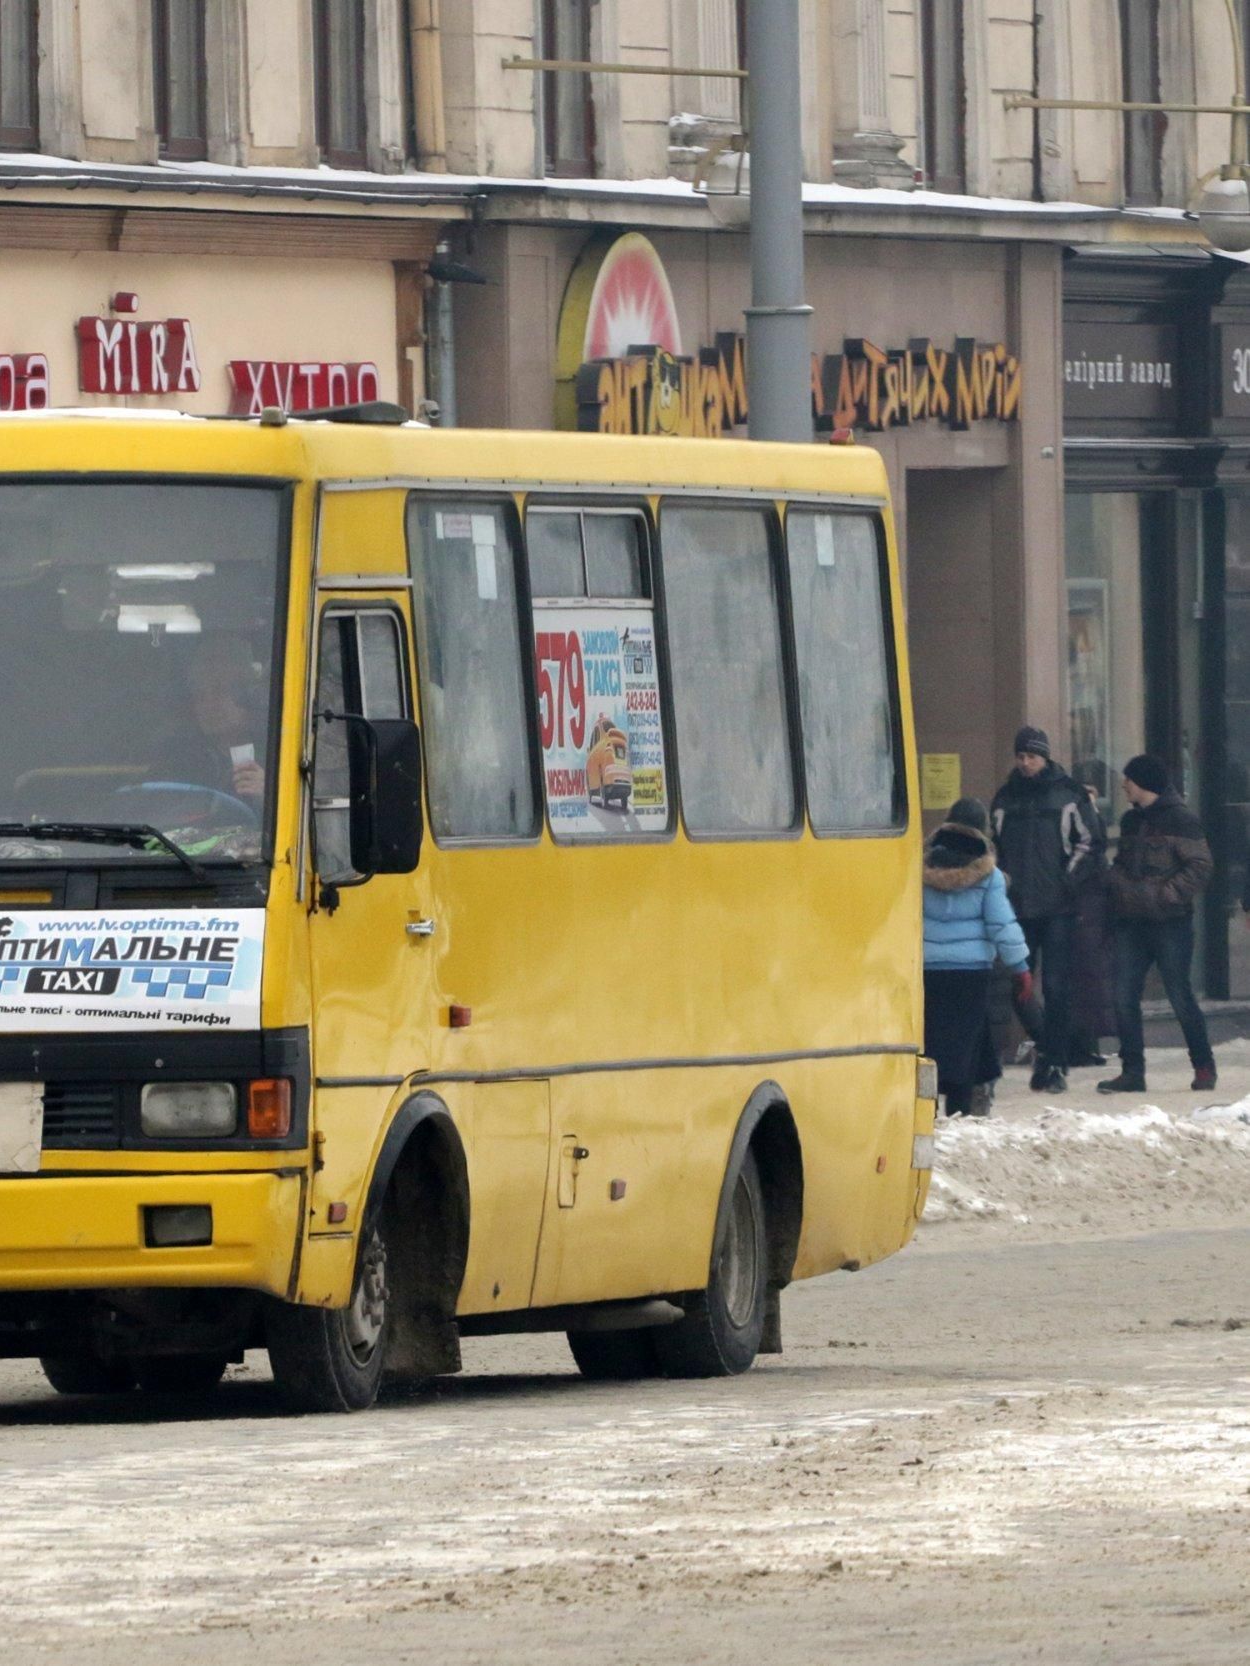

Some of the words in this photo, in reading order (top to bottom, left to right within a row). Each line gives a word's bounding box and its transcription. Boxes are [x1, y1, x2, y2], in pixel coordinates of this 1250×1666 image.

[535, 630, 586, 750] 579
[625, 690, 658, 711] 242-8-242
[38, 916, 241, 934] www.lv.optima.fm
[40, 970, 103, 992] TAXI
[30, 1005, 64, 1016] таксі
[74, 1007, 162, 1020] оптимальні
[166, 1010, 232, 1026] тарифи
